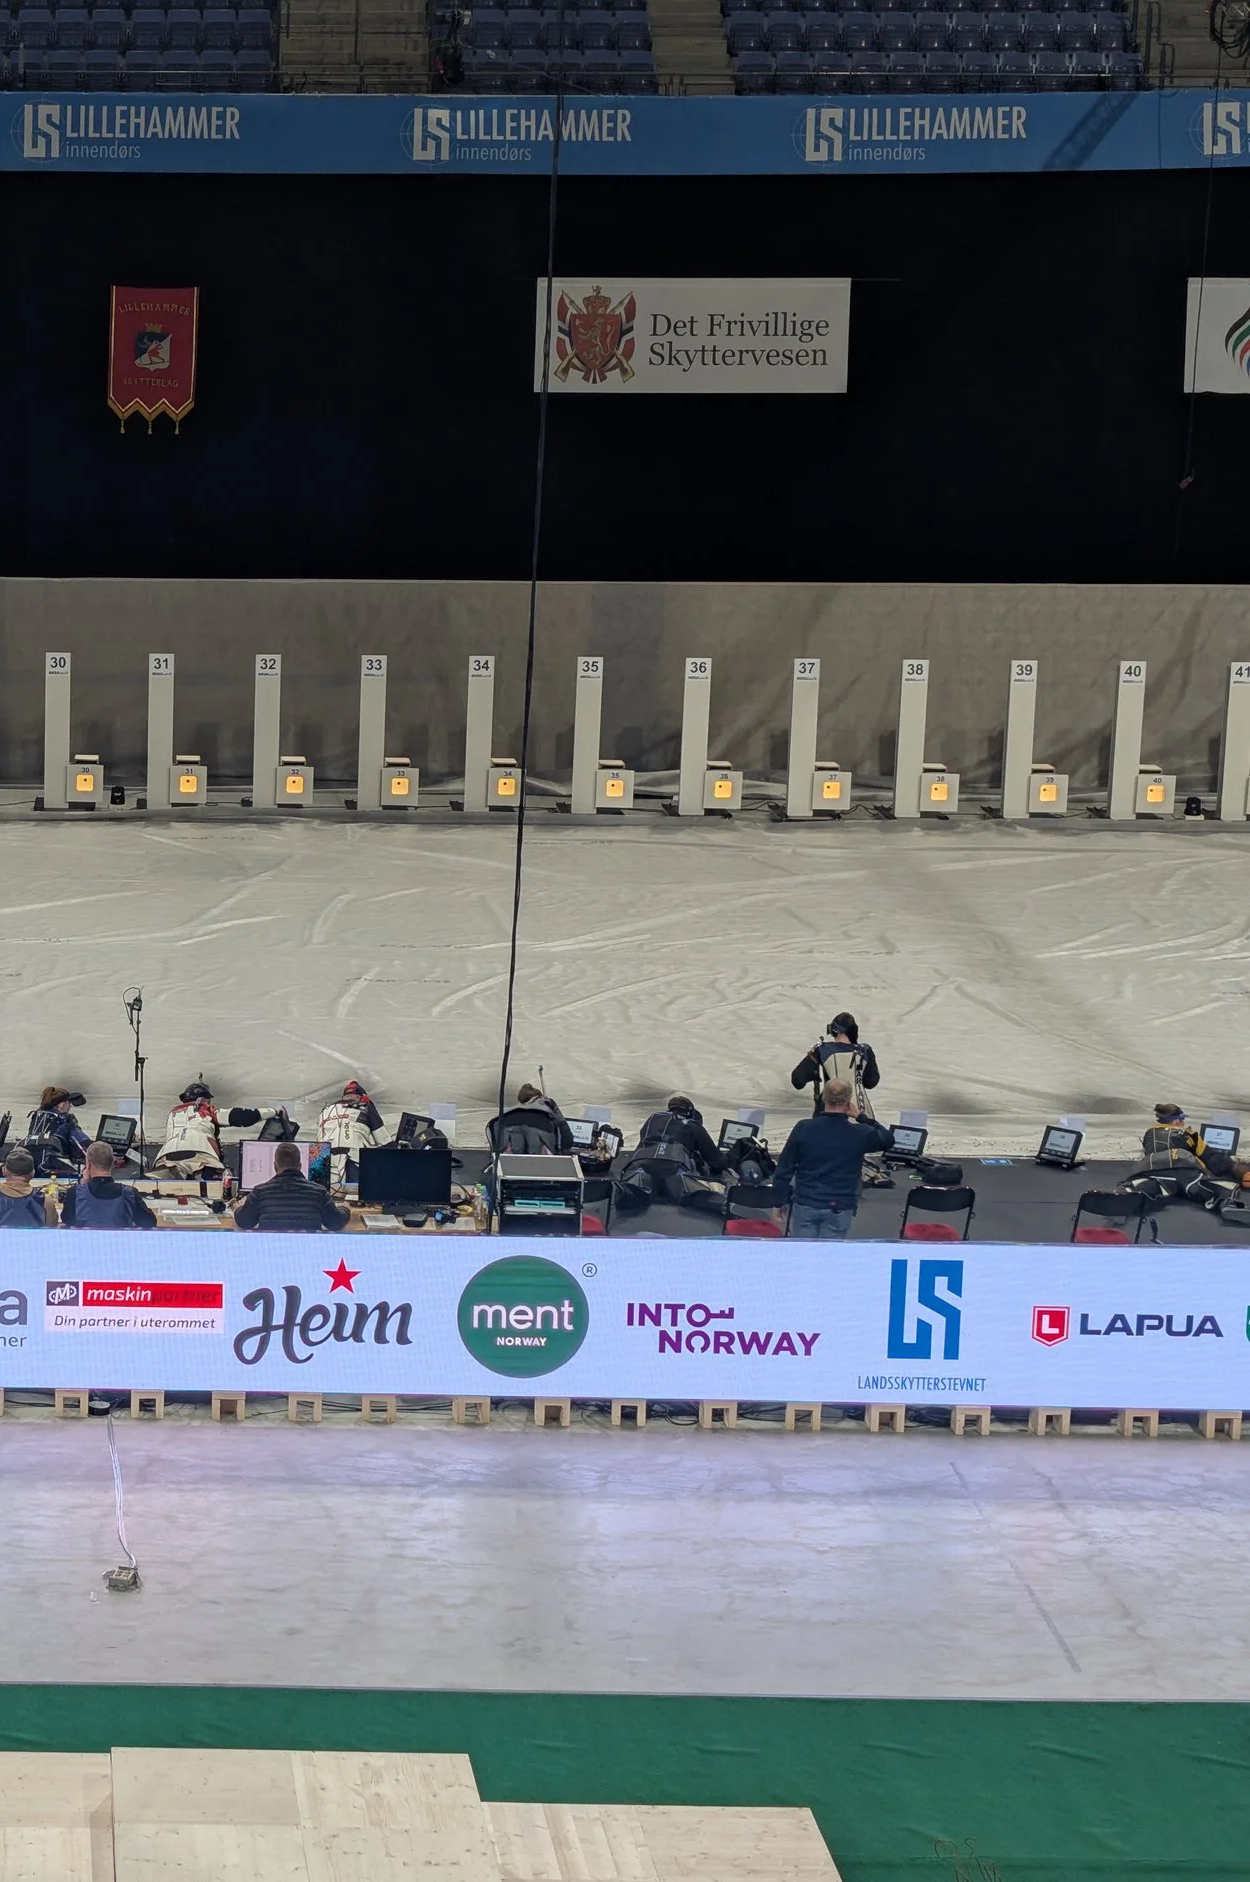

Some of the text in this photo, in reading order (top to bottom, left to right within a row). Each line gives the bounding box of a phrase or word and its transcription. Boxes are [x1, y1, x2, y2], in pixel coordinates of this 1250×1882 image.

[67, 105, 239, 142] LILLEHAMMER
[453, 104, 631, 145] LILLEHAMMER
[849, 106, 1026, 141] LILLEHAMMER
[66, 140, 144, 158] innendørs
[456, 142, 536, 160] innendørs
[848, 141, 929, 160] innendørs
[650, 312, 829, 348] Det Frivillige
[649, 338, 827, 372] Skyttervesen
[51, 657, 66, 668] 30
[154, 658, 168, 669] 31
[261, 659, 276, 669] 32
[366, 659, 382, 670] 33
[474, 660, 489, 671] 34
[583, 661, 598, 672] 35
[691, 662, 706, 673] 36
[799, 663, 815, 673] 37
[907, 664, 923, 675] 38
[1016, 665, 1032, 675] 39
[1125, 665, 1141, 677] 40
[1235, 666, 1250, 677] 41
[81, 766, 90, 774] 30
[936, 775, 946, 783] 38
[1153, 776, 1162, 784] 40
[473, 1300, 573, 1330] ment
[54, 1315, 216, 1329] Din partner i uterommet
[233, 1285, 413, 1366] Heim
[1080, 1313, 1223, 1337] LAPUA
[496, 1336, 548, 1348] NORWAY
[659, 1330, 820, 1356] NORWAY
[858, 1376, 986, 1391] LANDSSKYTTERSTEVNET
